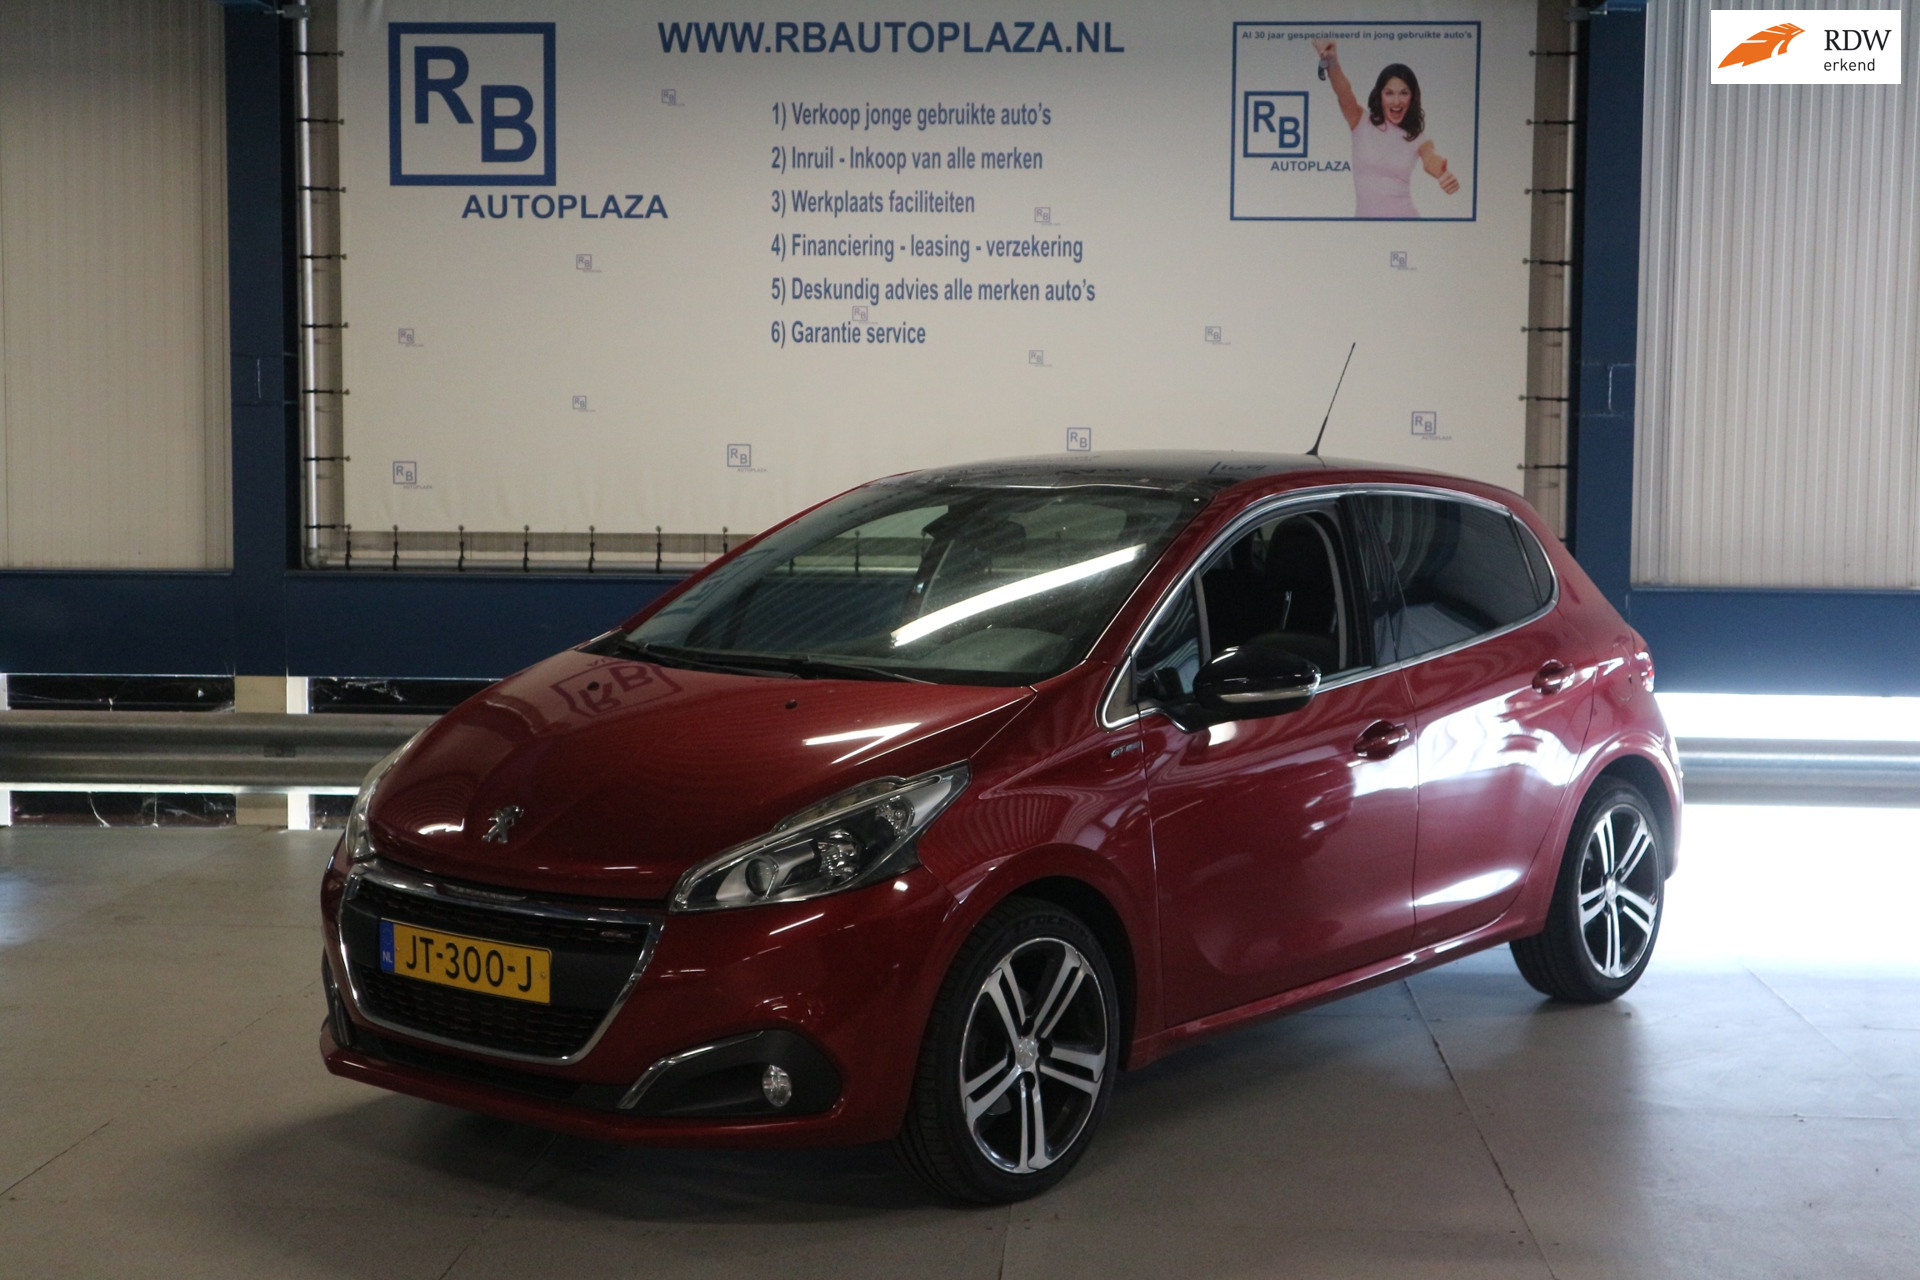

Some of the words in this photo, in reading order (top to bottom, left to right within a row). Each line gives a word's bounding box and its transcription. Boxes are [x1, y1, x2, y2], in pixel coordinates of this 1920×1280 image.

[657, 21, 1125, 54] WWW.RBAUTOPLAZA.NL
[1255, 31, 1266, 39] 30
[1267, 31, 1285, 40] jaar
[1288, 31, 1360, 41] gespecialiseerd
[1362, 31, 1372, 39] in
[1374, 31, 1395, 41] jong
[1397, 31, 1441, 41] gebruikte
[1443, 31, 1473, 39] auto's
[771, 102, 787, 130] 1)
[791, 102, 860, 131] Verkoop
[863, 102, 912, 131] jonge
[917, 102, 996, 131] gebruikte
[1000, 102, 1052, 126] auto's
[771, 146, 787, 174] 2)
[791, 146, 834, 169] Inruil
[849, 146, 907, 175] Inkoop
[911, 152, 942, 170] van
[946, 146, 976, 170] alle
[981, 146, 1043, 170] merken
[1270, 161, 1351, 173] AUTOPLAZA
[461, 193, 669, 220] AUTOPLAZA
[771, 189, 787, 218] 3)
[791, 189, 884, 218] Werkplaats
[888, 189, 975, 213] faciliteiten
[771, 233, 787, 262] 4)
[791, 233, 895, 262] Financiering
[910, 233, 970, 263] leasing
[985, 233, 1084, 263] verzekering
[771, 277, 787, 306] 5)
[791, 277, 880, 306] Deskundig
[884, 277, 939, 301] advies
[943, 277, 973, 301] alle
[977, 278, 1040, 301] merken
[1044, 278, 1096, 302] auto's
[771, 320, 787, 349] 6)
[791, 320, 862, 345] Garantie
[865, 320, 927, 345] service
[382, 951, 393, 963] NL
[406, 935, 532, 992] JT-300-J
